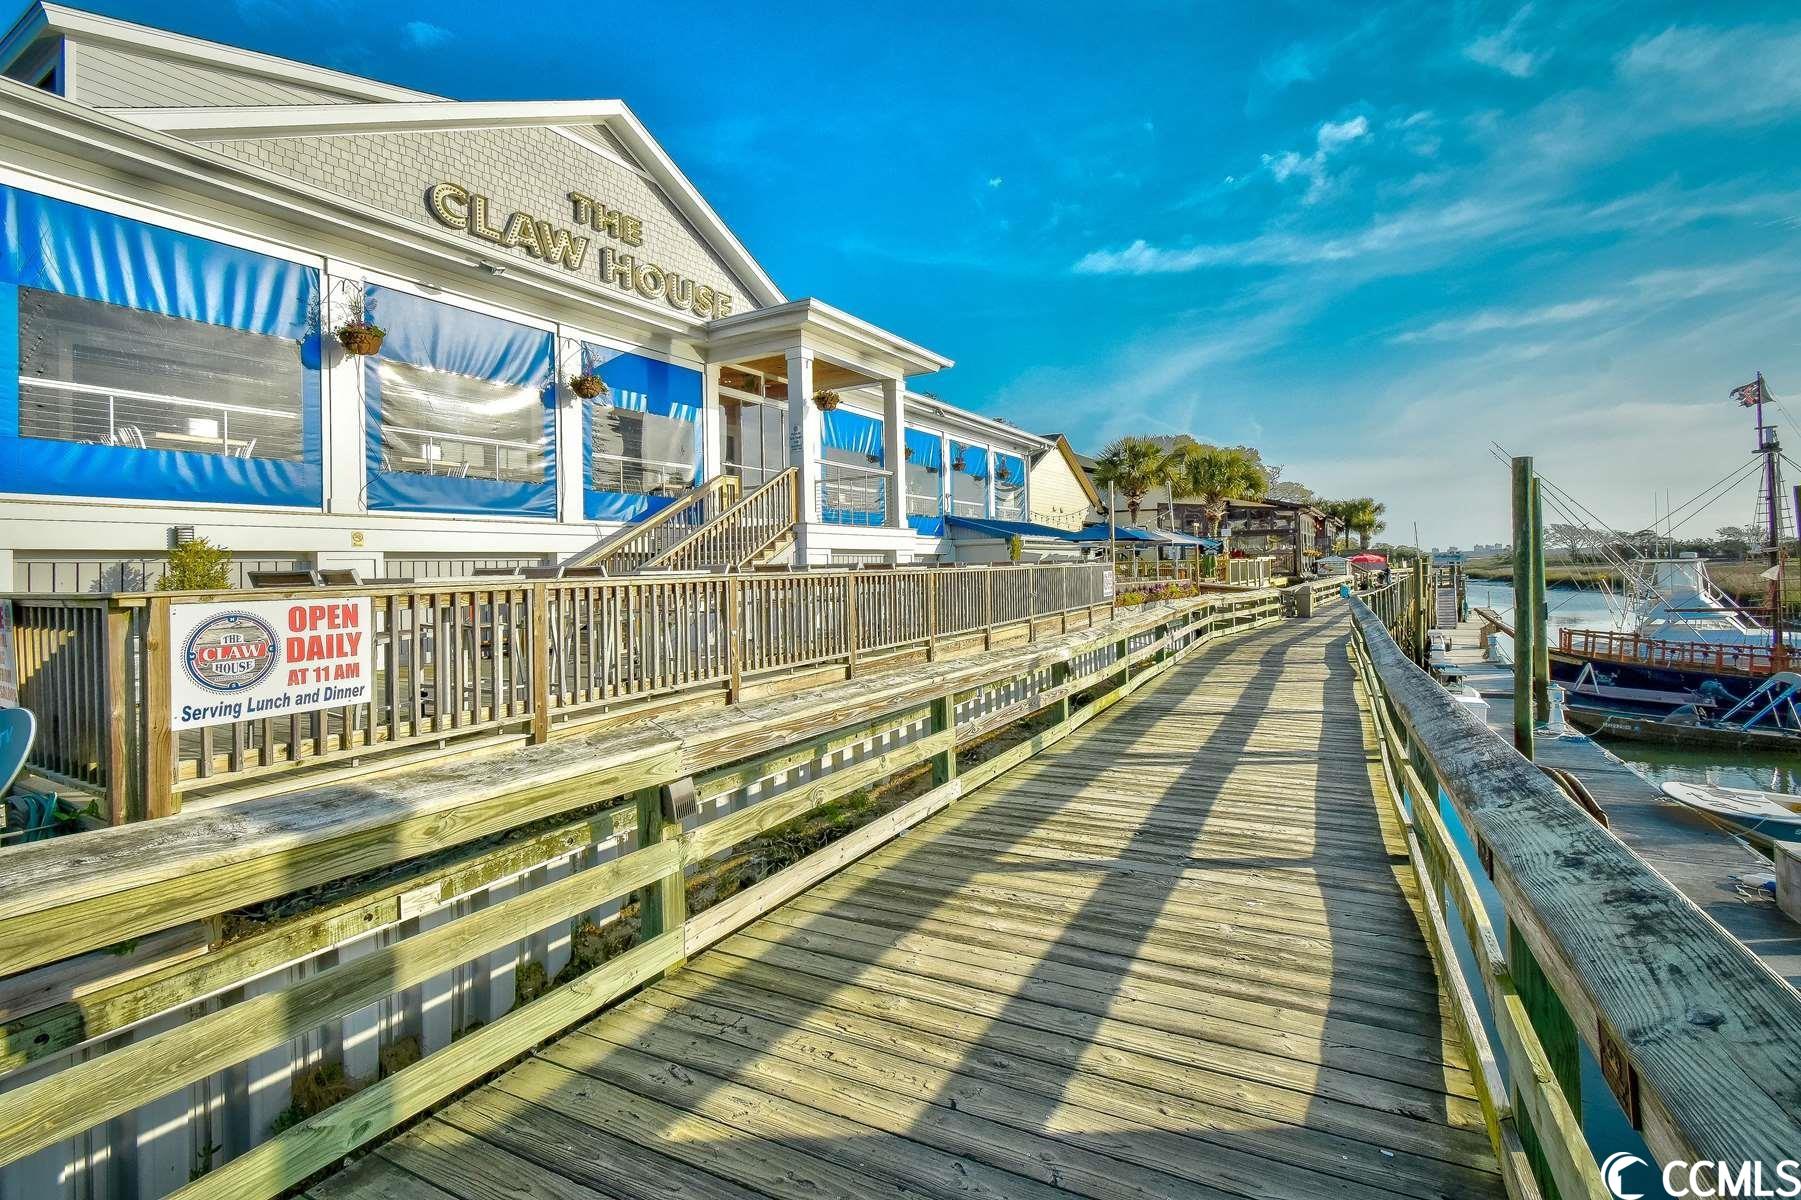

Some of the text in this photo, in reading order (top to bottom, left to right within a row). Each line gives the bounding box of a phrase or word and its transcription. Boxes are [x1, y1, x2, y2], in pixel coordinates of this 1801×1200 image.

[567, 191, 643, 248] THE
[424, 182, 733, 320] CLAW HOUSE
[288, 603, 359, 633] OPEN
[202, 643, 263, 661] CLAW
[223, 634, 243, 643] THE
[286, 631, 363, 664] DAILY
[215, 661, 252, 674] HOUSE
[287, 667, 309, 687] AT
[181, 684, 366, 723] Serving Lunch and Dinner
